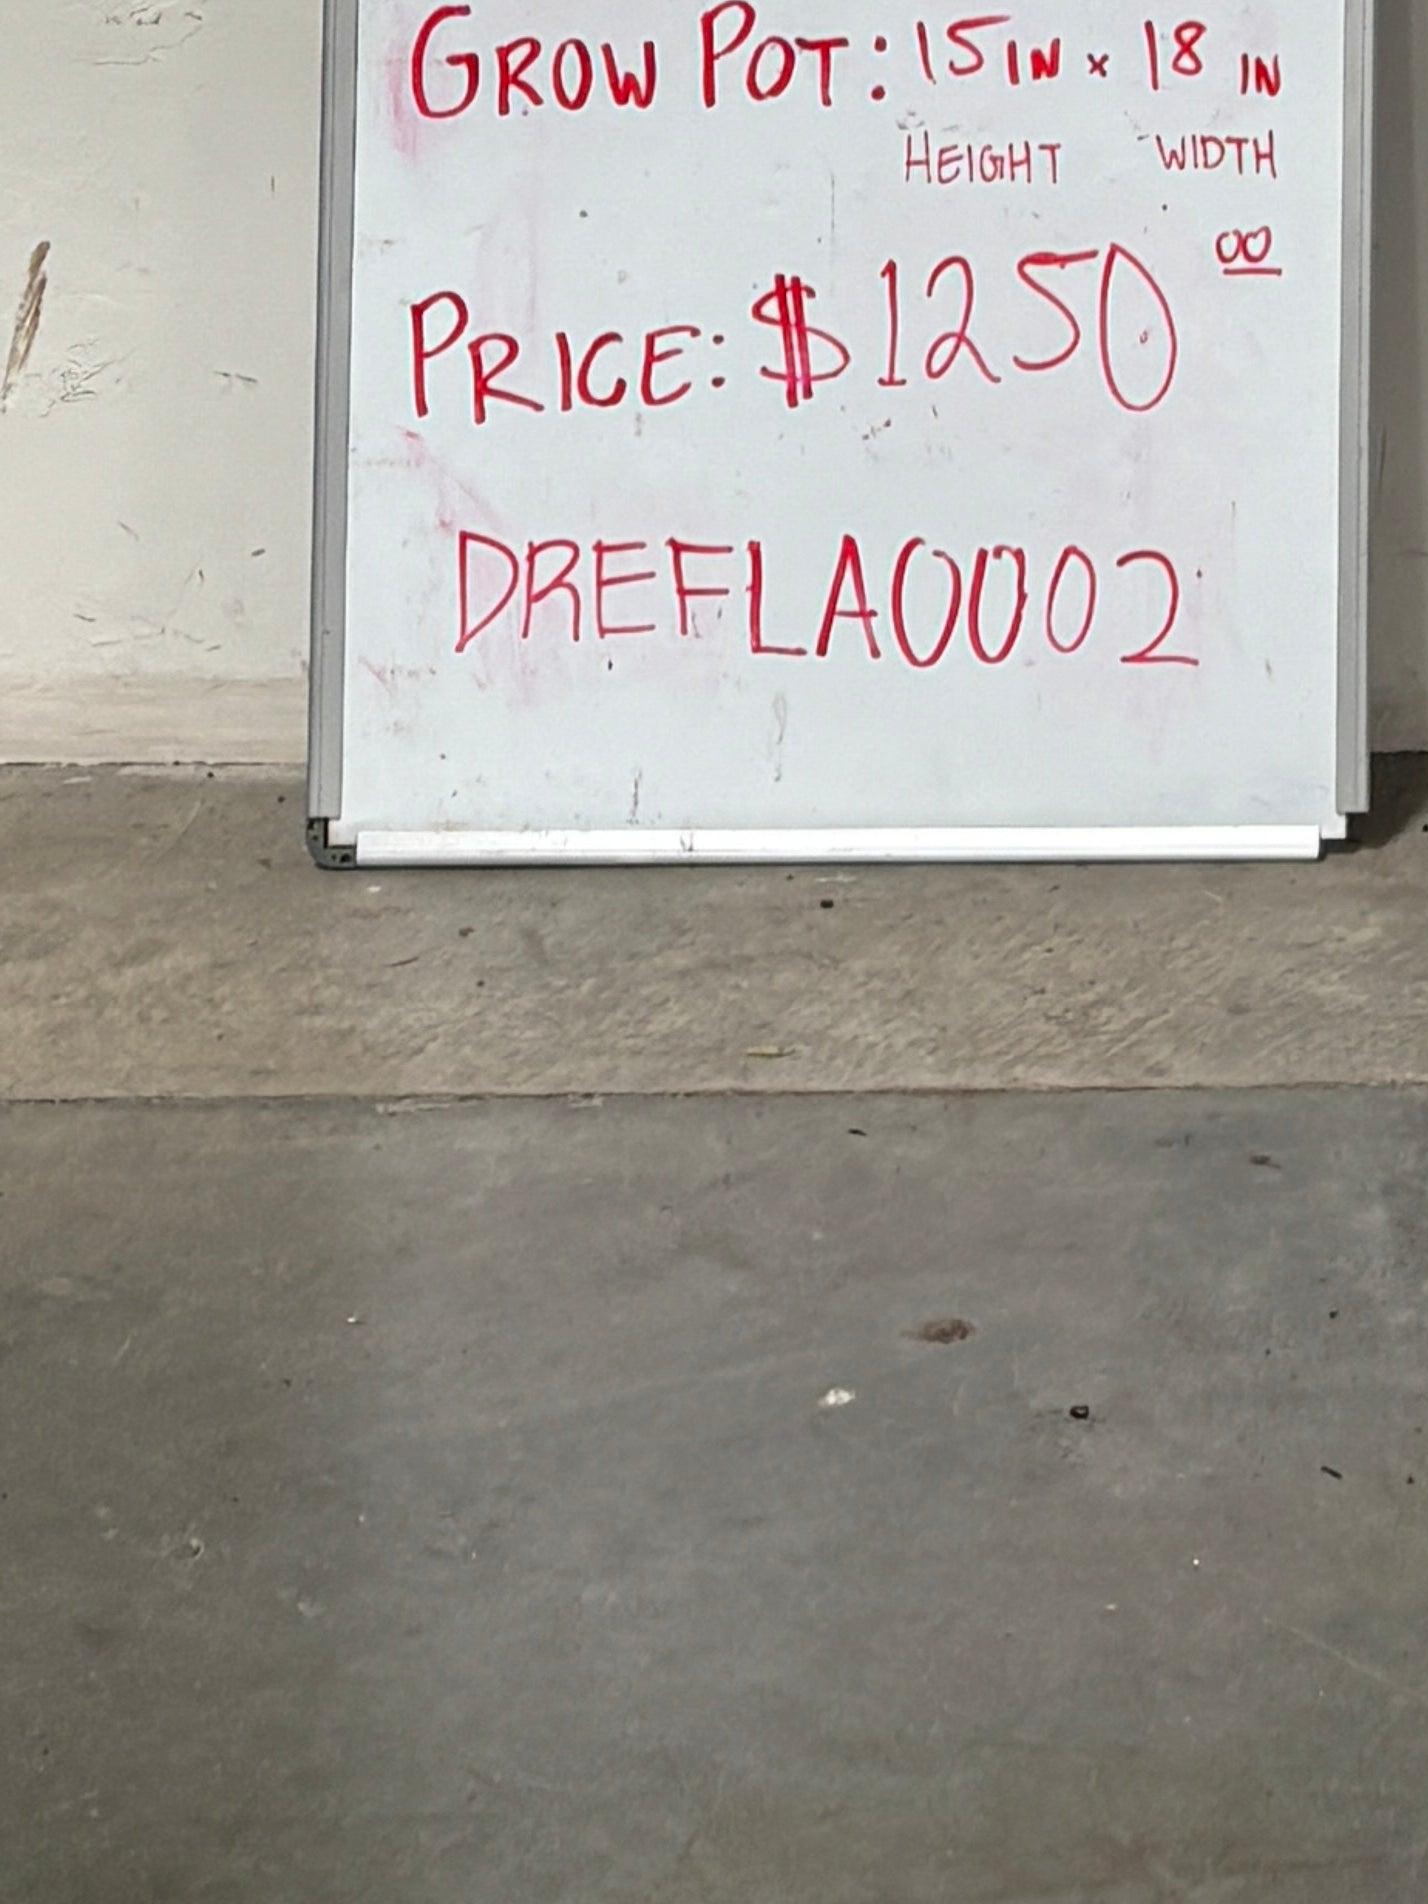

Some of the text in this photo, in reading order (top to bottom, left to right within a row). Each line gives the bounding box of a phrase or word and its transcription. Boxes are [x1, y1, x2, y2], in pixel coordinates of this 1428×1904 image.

[409, 6, 656, 119] GROW
[700, 1, 885, 108] POT:
[1144, 21, 1205, 90] 18
[1239, 53, 1281, 97] IN
[906, 129, 1277, 183] HEIGHT WIDTH
[410, 292, 724, 424] PRICE:
